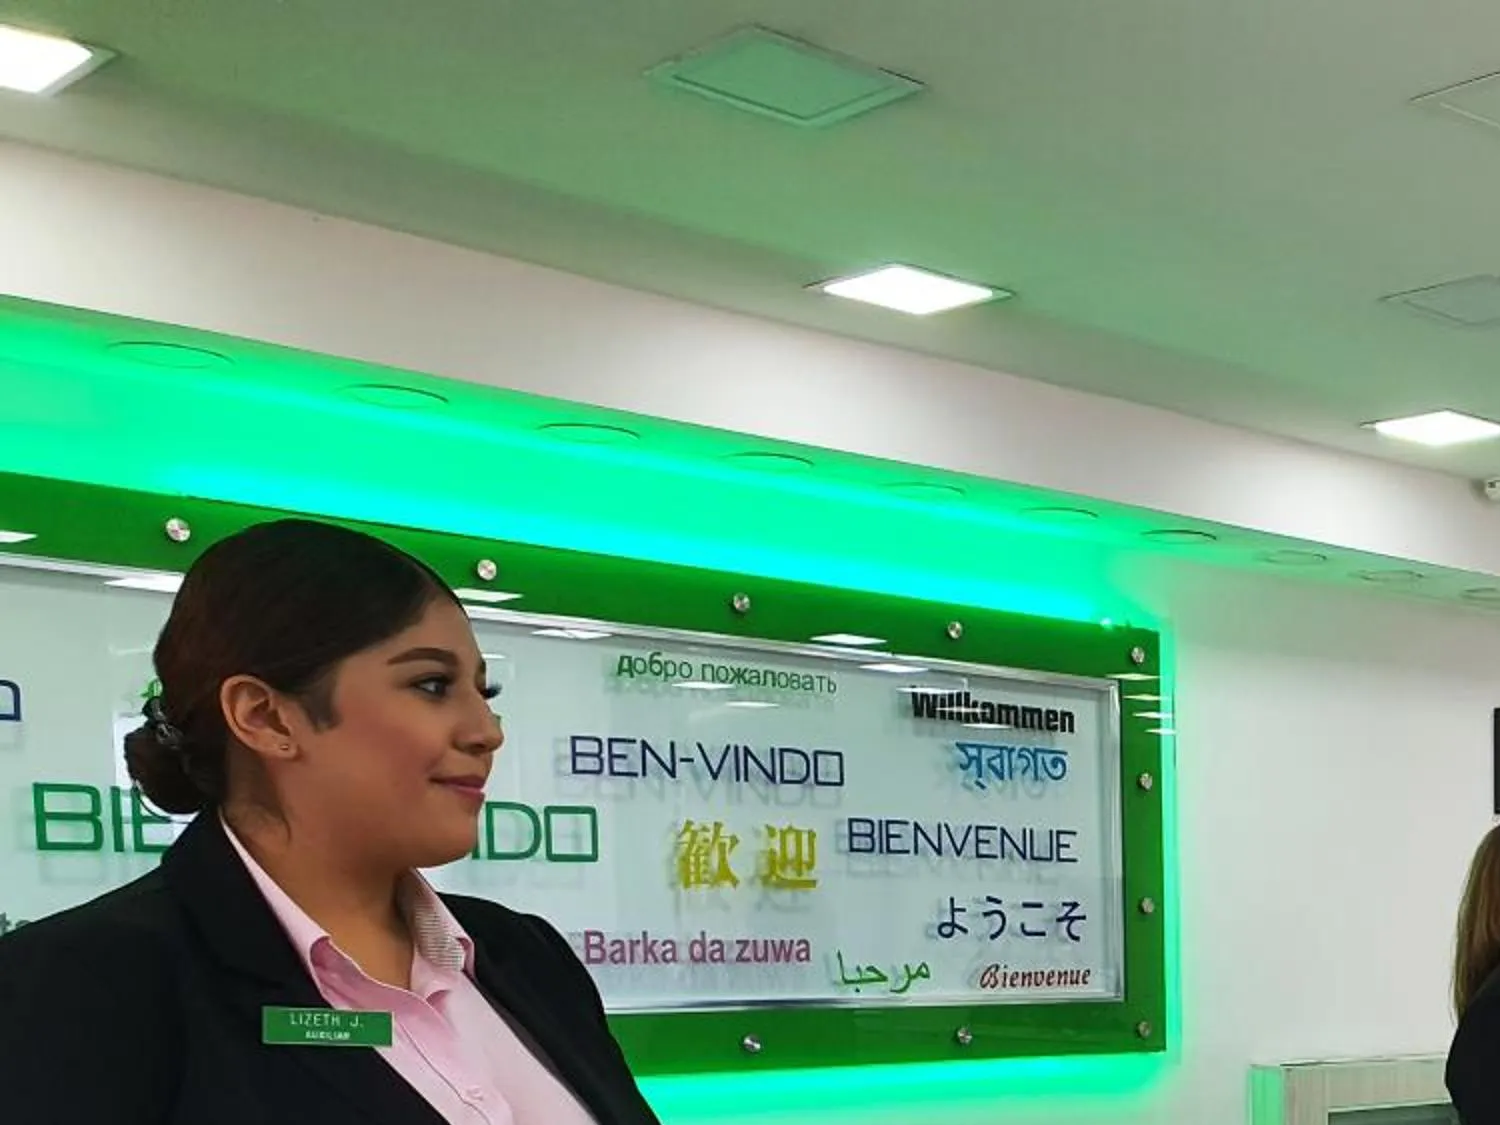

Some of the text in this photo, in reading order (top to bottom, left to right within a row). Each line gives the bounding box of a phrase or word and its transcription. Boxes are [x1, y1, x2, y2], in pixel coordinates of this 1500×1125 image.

[616, 652, 838, 694] добро пожаловать
[570, 735, 845, 786] BEN-VINDO
[848, 818, 1078, 863] BIENVENUE
[937, 896, 1087, 943] ようこそ
[584, 930, 811, 965] Barka da zuwa
[838, 950, 931, 993] مرحبا
[979, 963, 1091, 989] Bienvenue
[289, 1012, 364, 1028] LIZETH J.
